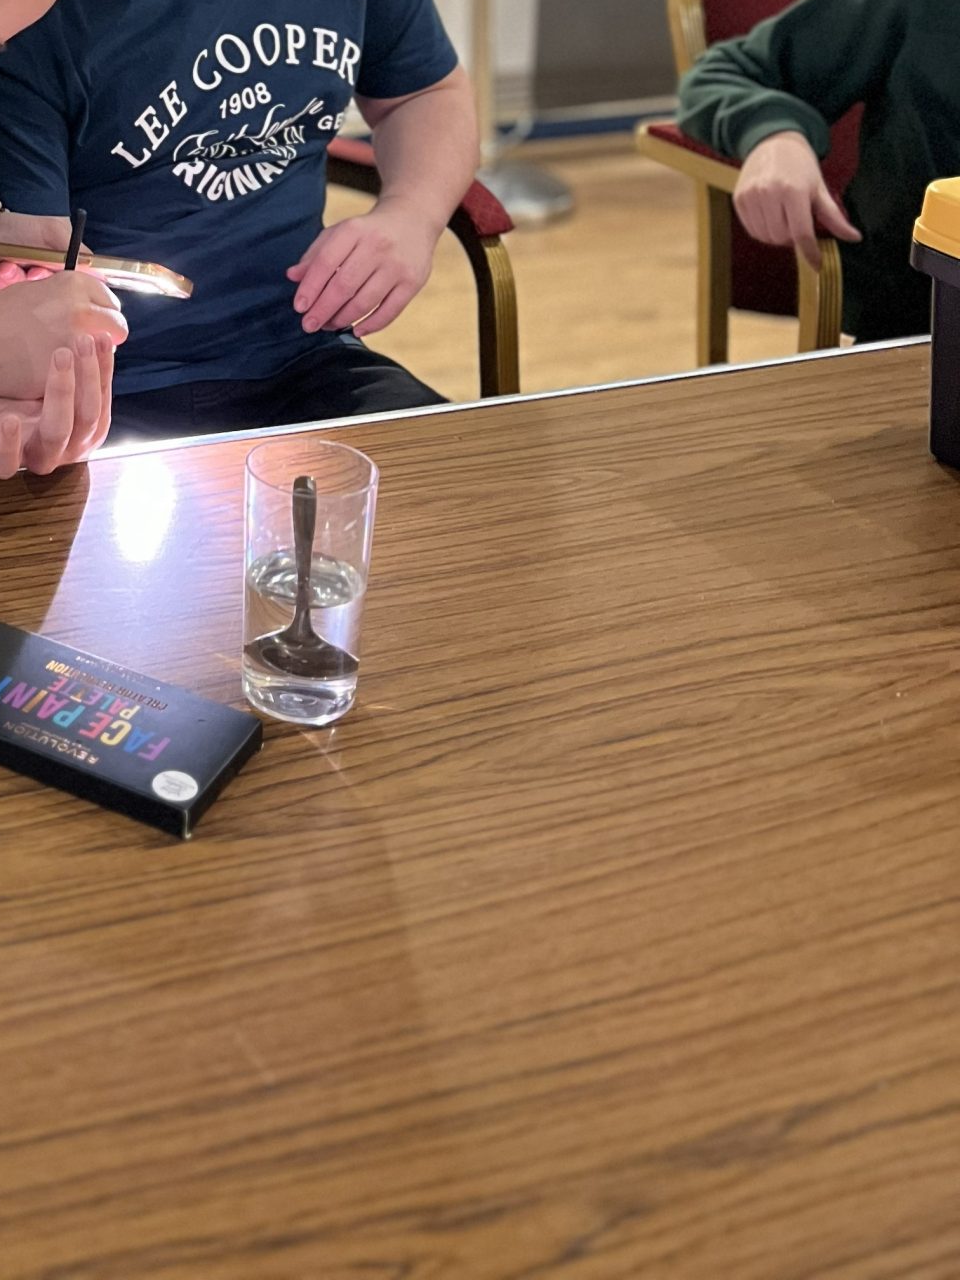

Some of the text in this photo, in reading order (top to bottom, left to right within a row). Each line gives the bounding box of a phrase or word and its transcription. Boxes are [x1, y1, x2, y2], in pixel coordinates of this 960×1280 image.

[111, 80, 188, 169] LEE
[192, 23, 361, 91] COOPER
[219, 82, 272, 119] 1908
[172, 157, 290, 201] RIGINA
[48, 675, 141, 720] PALETTE
[3, 721, 100, 764] REVOLUTION
[79, 711, 171, 761] FACE
